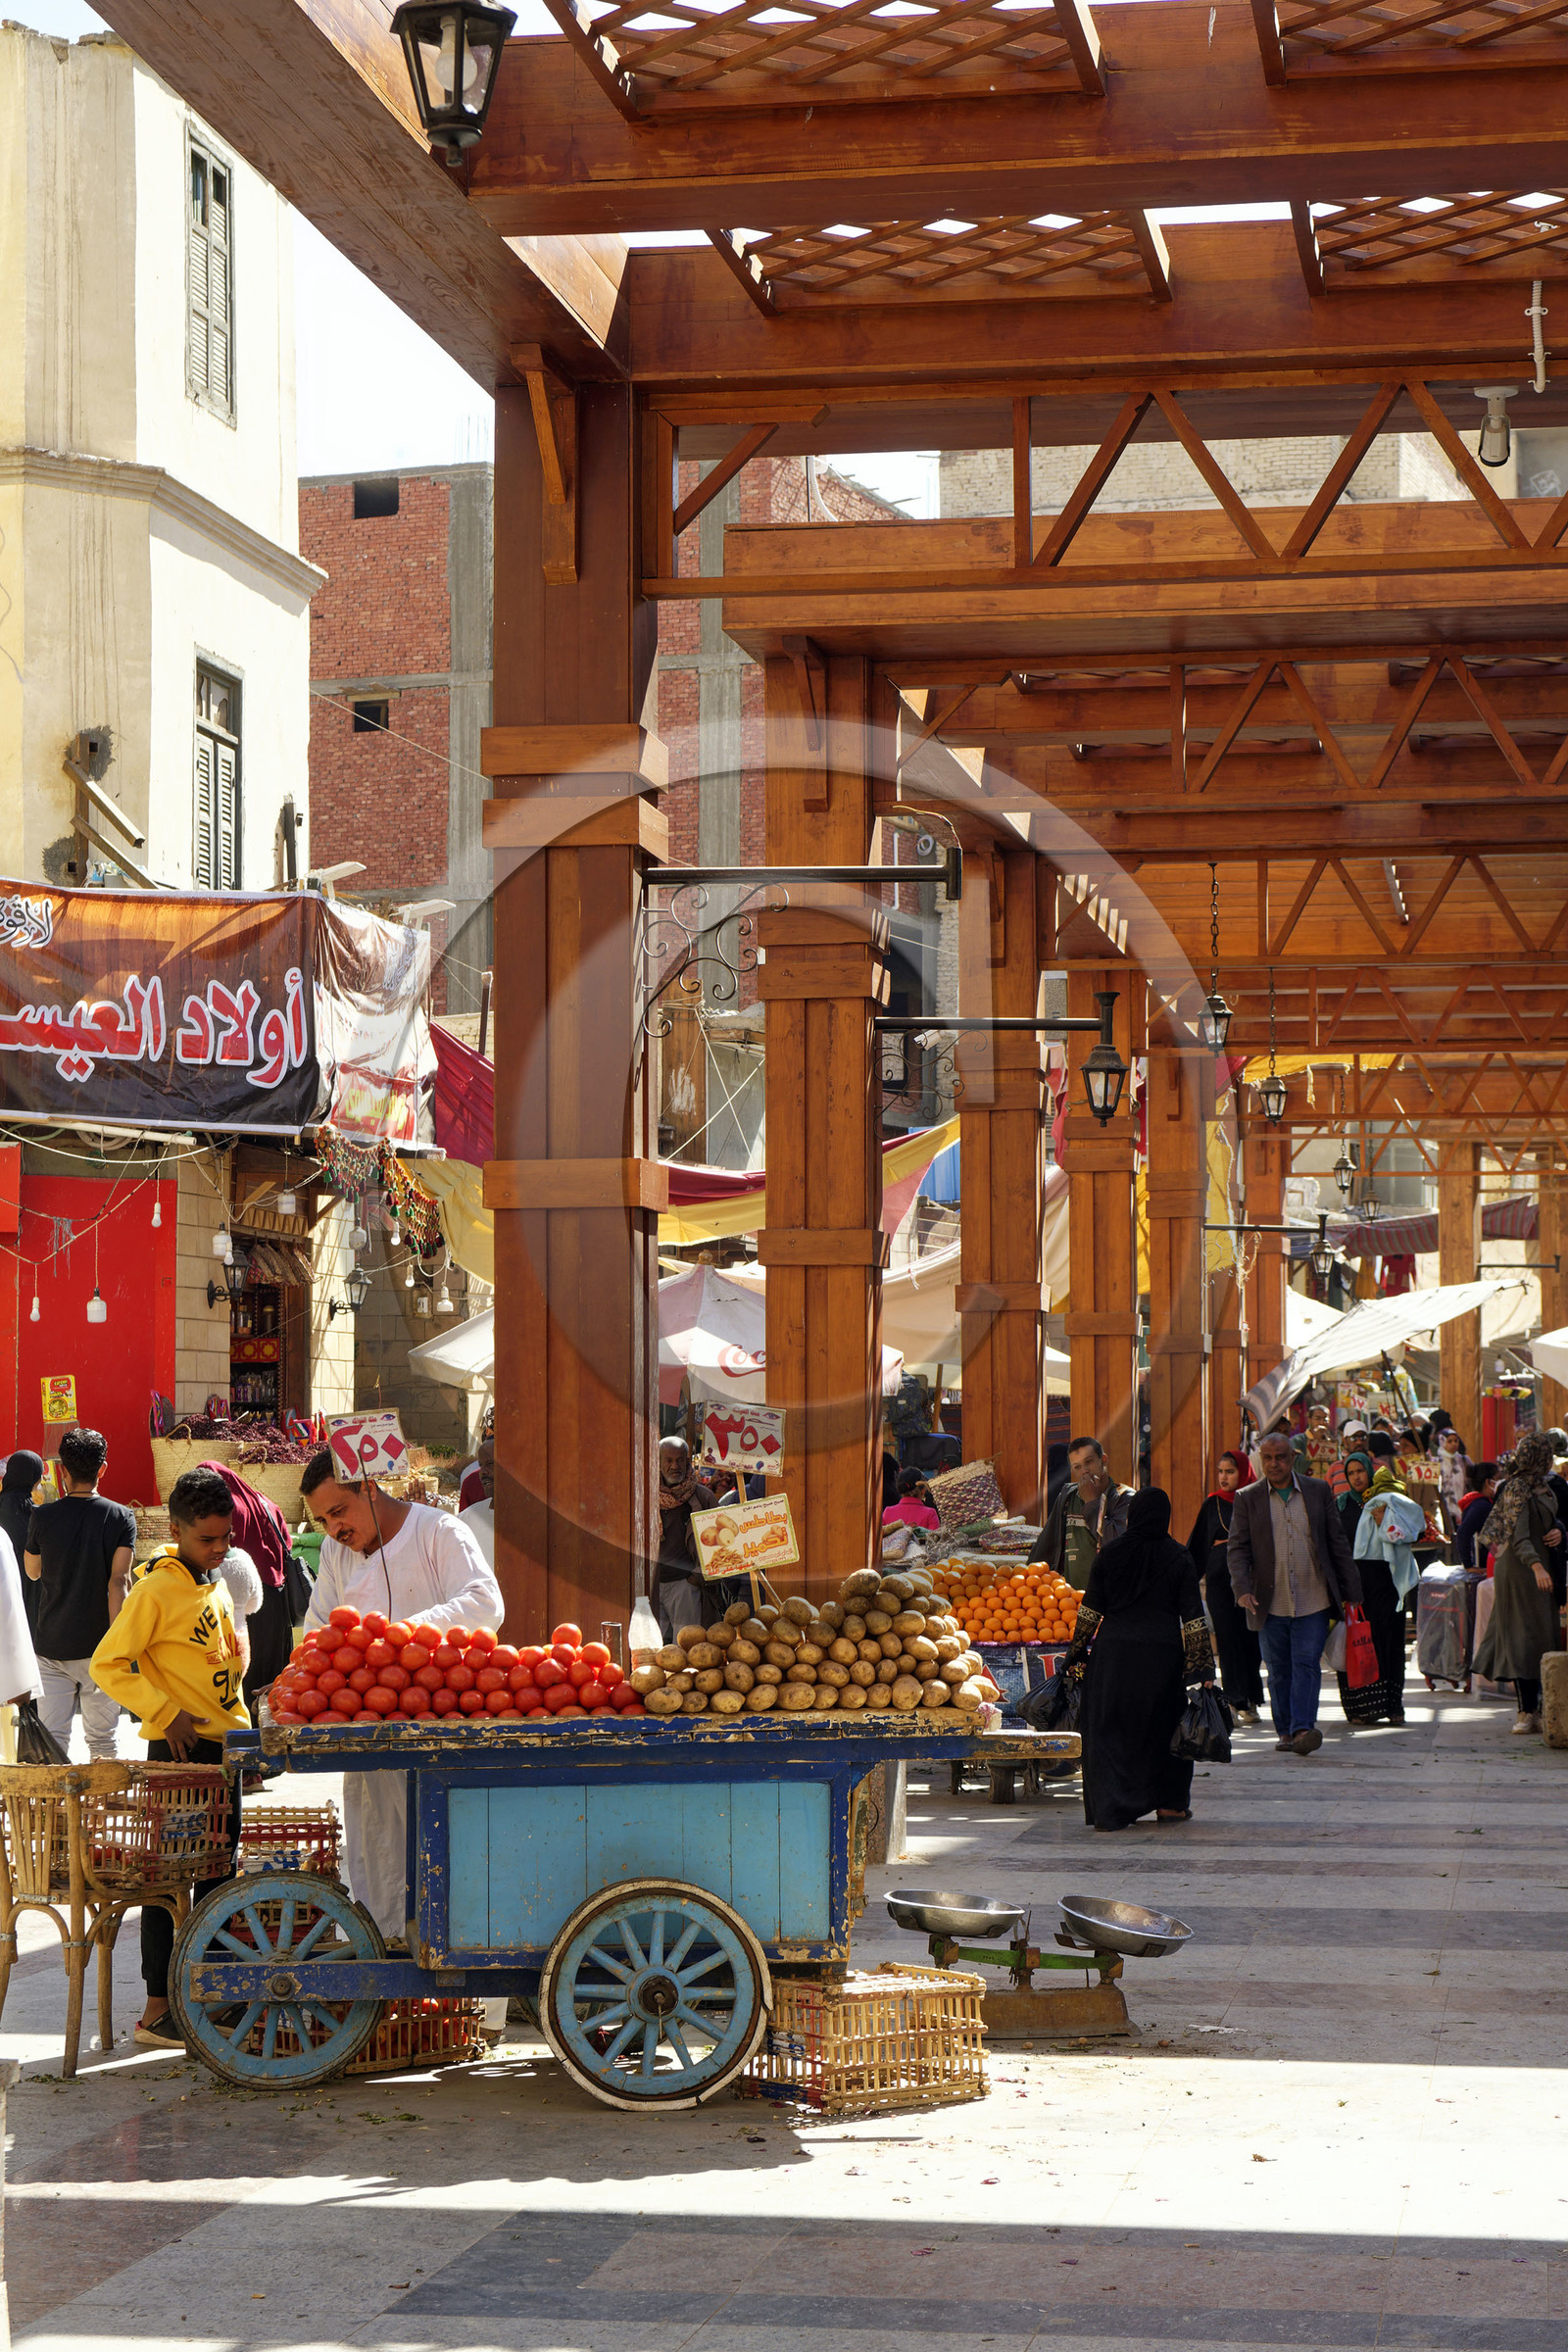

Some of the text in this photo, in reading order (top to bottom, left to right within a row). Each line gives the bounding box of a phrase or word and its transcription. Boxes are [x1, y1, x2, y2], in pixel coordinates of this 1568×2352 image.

[176, 967, 308, 1088] أولاد
[739, 1511, 787, 1534] بطاطس
[743, 1527, 788, 1558] تحمير
[189, 1604, 219, 1646] WE
